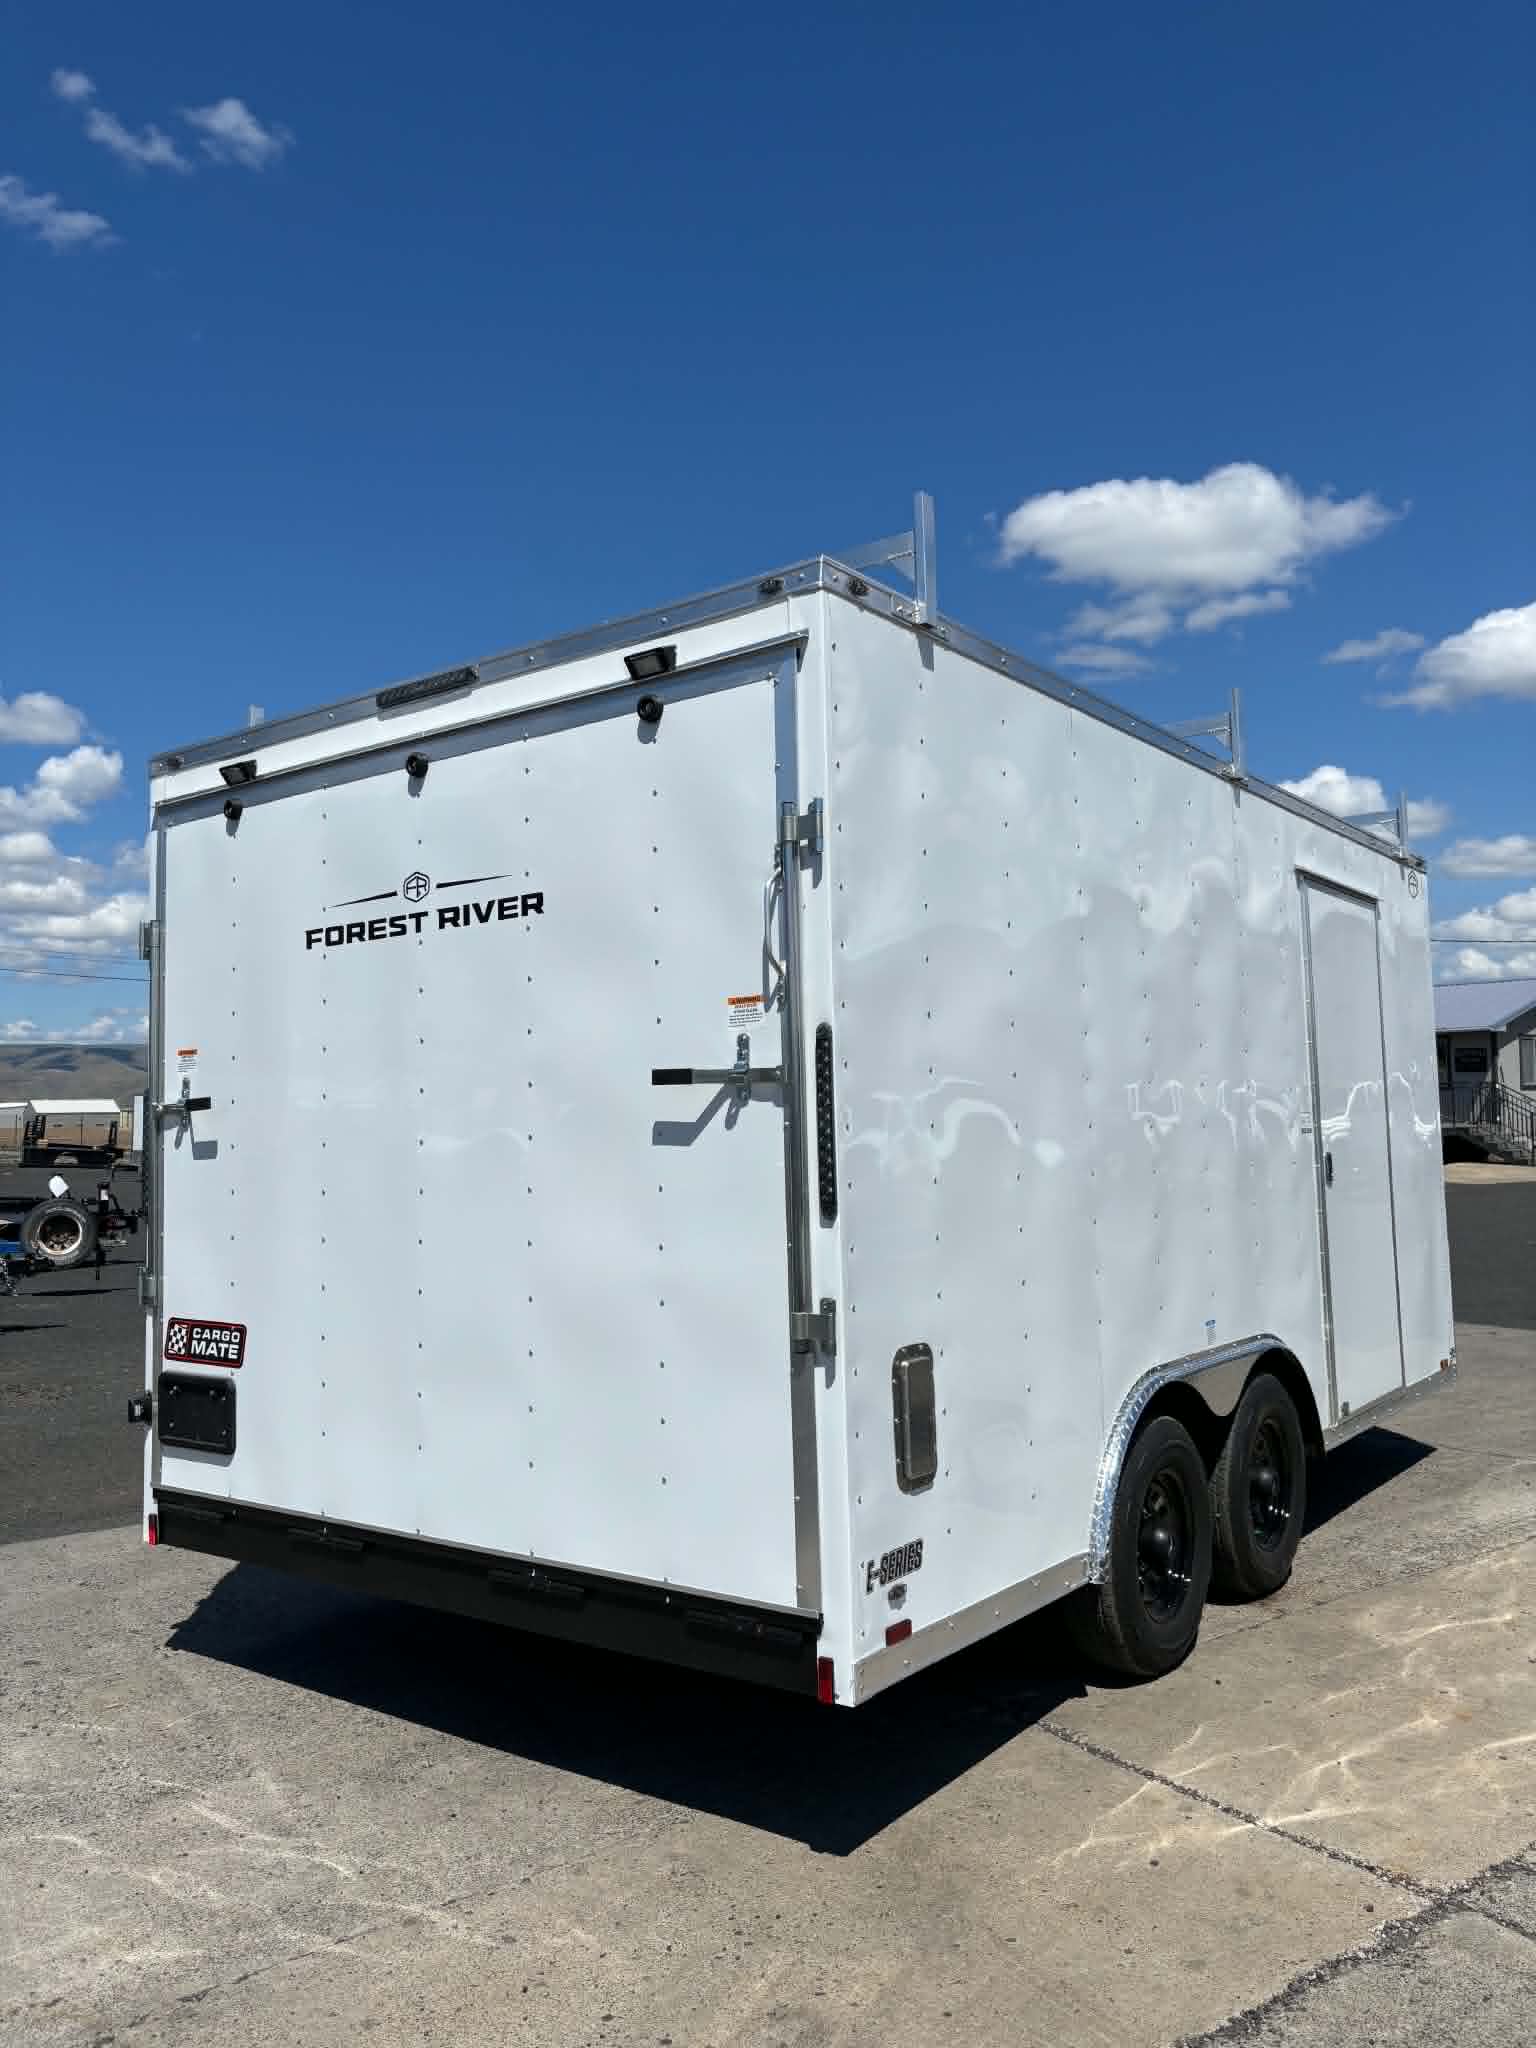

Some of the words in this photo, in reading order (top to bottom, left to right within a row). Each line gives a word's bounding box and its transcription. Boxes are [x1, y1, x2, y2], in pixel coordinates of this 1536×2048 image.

[305, 911, 428, 950] FOREST
[437, 892, 545, 930] RIVER
[191, 1340, 239, 1359] MATE
[192, 1327, 240, 1343] CARGO
[866, 1538, 923, 1594] E-SERIES
